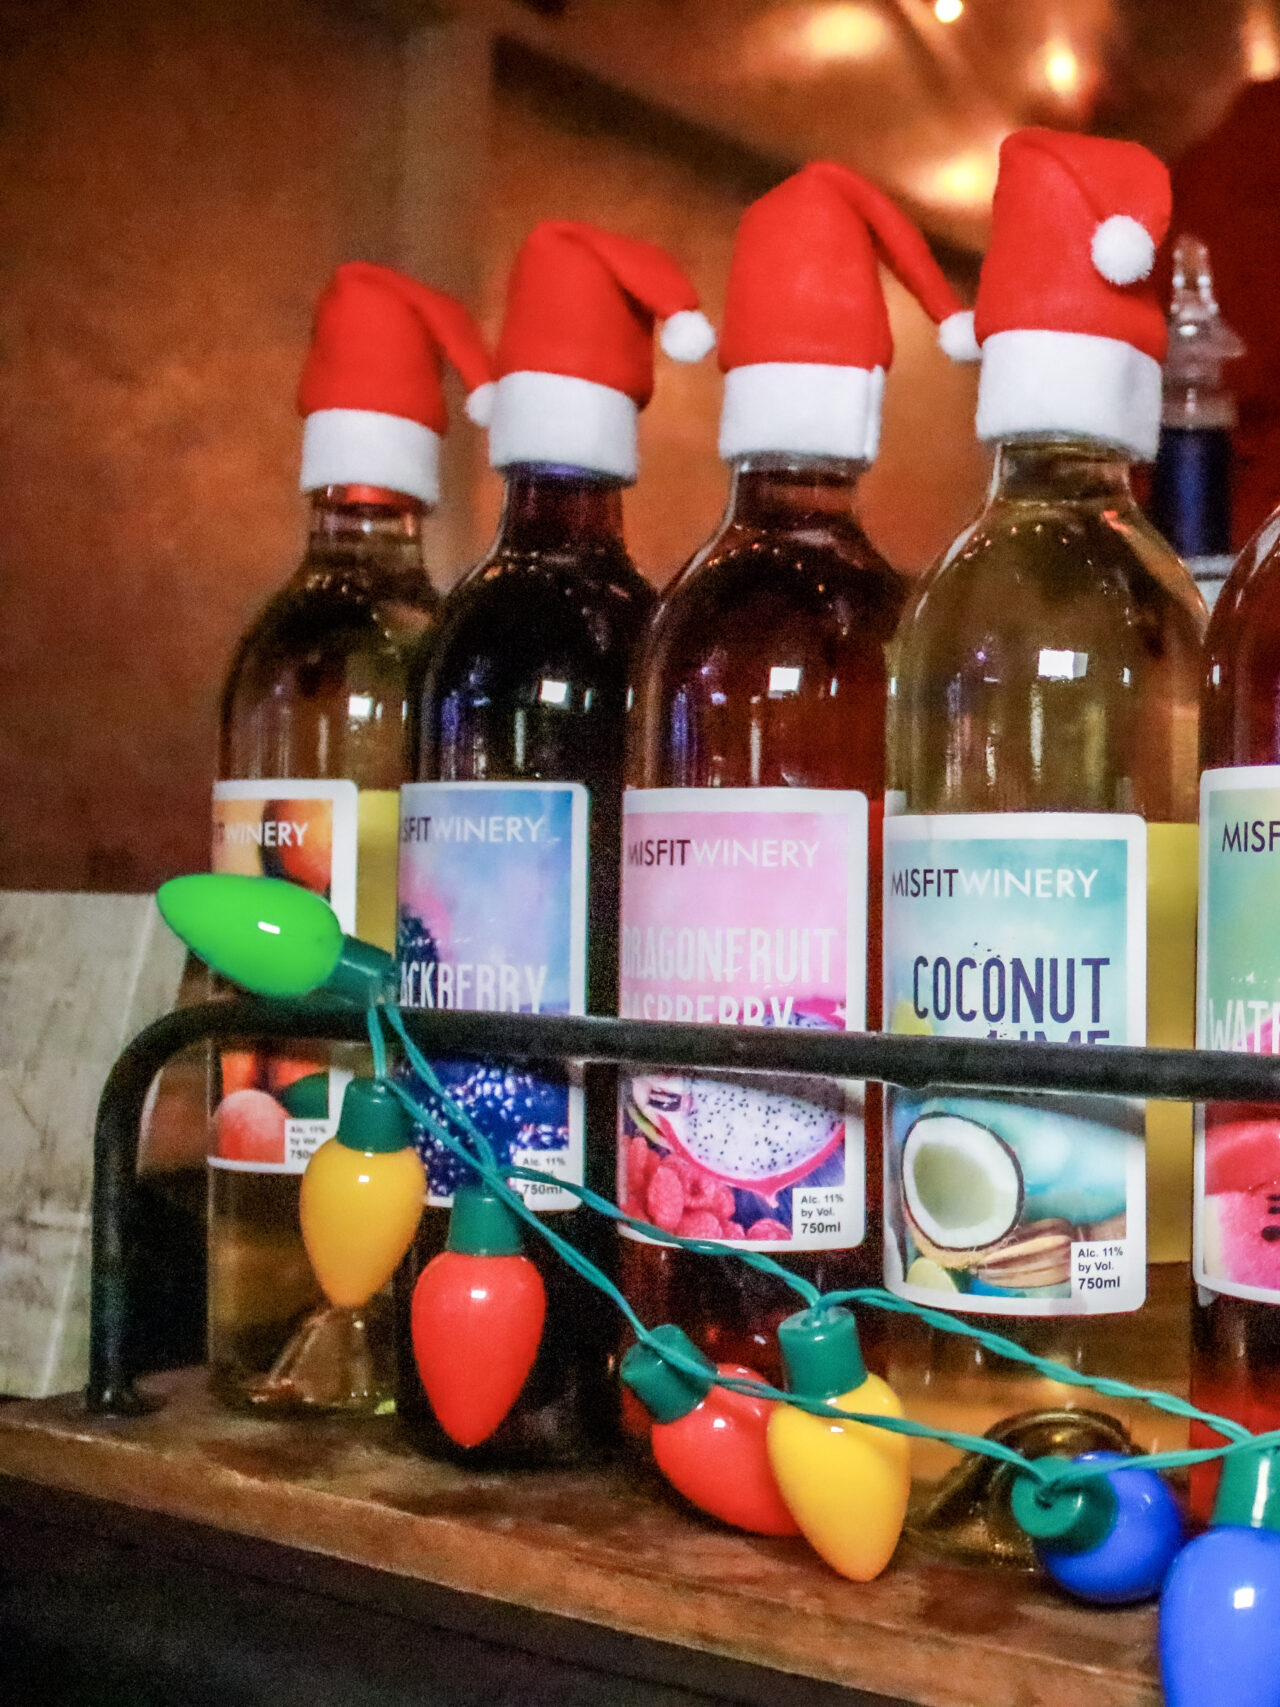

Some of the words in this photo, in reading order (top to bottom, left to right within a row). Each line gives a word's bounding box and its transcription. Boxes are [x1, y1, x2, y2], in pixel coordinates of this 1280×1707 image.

[913, 955, 1111, 1024] COCONUT
[824, 1194, 844, 1203] 11%
[801, 1209, 813, 1218] by
[801, 1222, 841, 1234] 750ml
[1103, 1246, 1123, 1256] 11%
[1078, 1262, 1091, 1274] by
[1095, 1261, 1114, 1271] Vol.
[1078, 1276, 1120, 1290] 750ml
